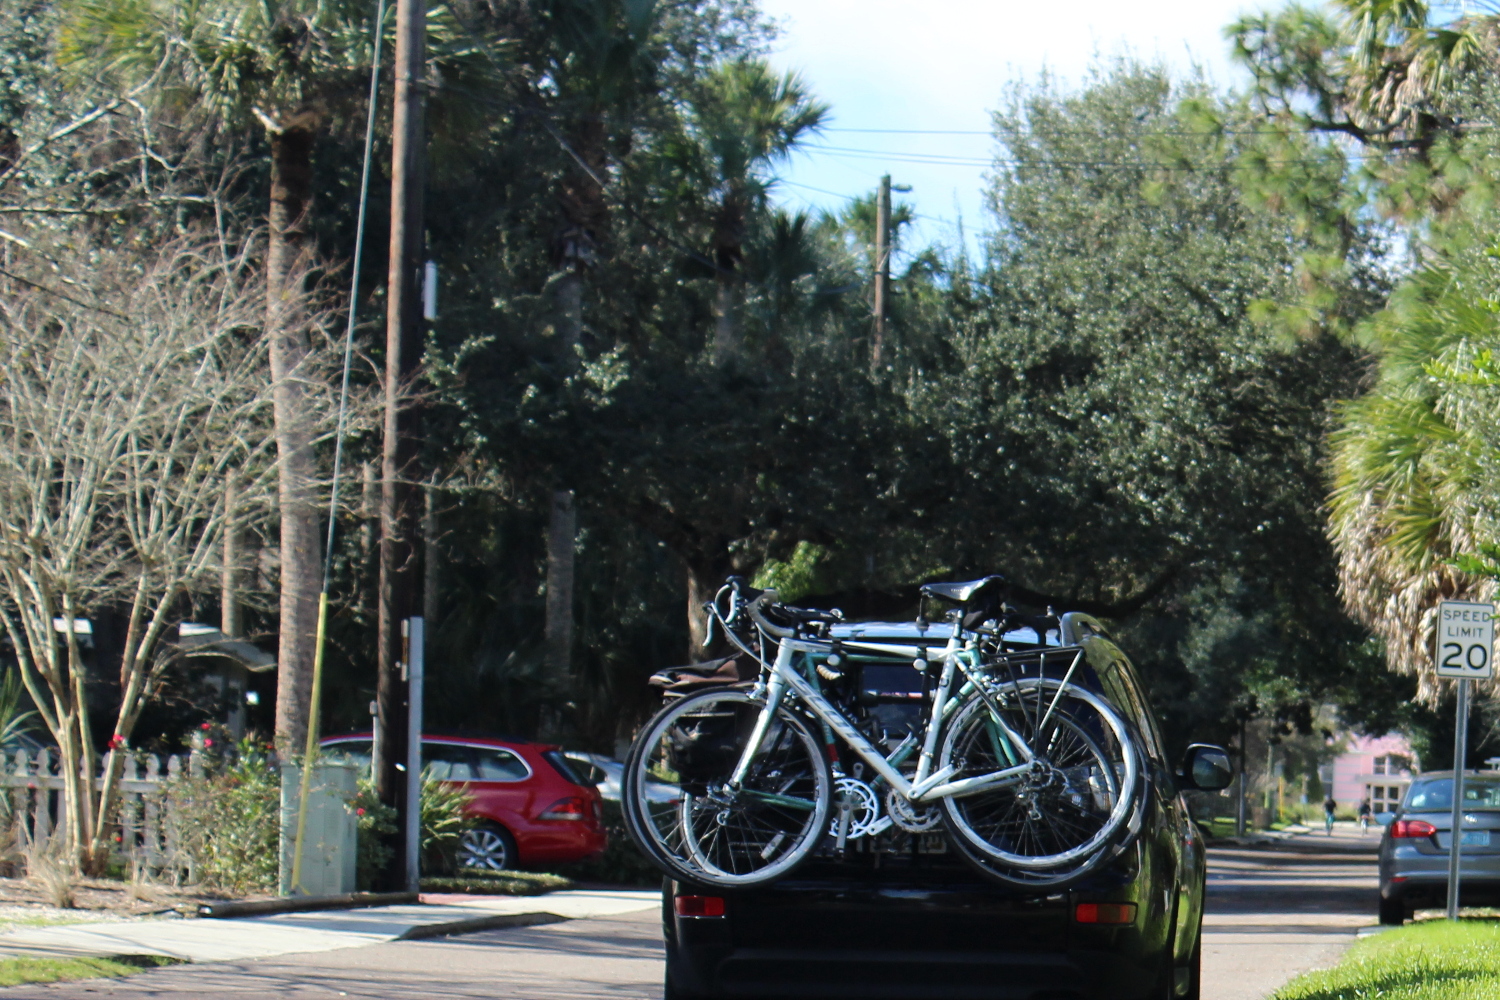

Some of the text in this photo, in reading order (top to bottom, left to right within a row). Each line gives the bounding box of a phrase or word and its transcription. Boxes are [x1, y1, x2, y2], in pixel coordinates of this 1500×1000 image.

[1443, 609, 1490, 622] SPEED
[1447, 626, 1484, 638] LIMIT
[1442, 642, 1488, 670] 20
[789, 679, 877, 753] SCOTT
